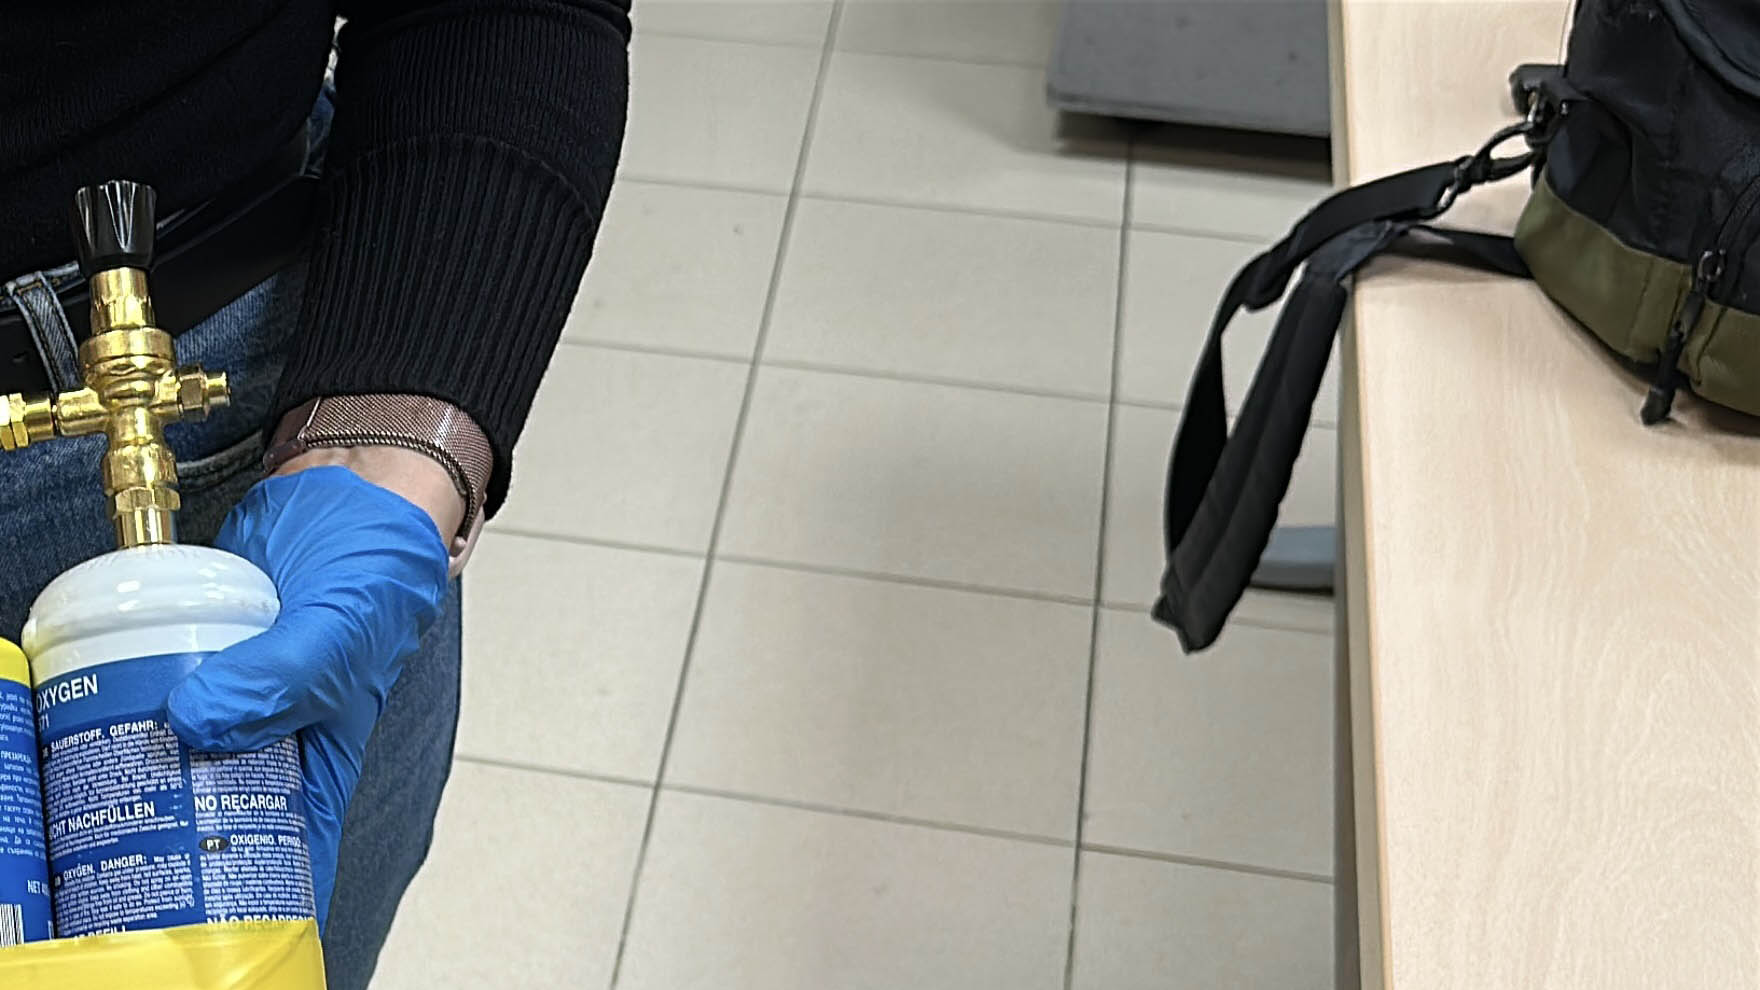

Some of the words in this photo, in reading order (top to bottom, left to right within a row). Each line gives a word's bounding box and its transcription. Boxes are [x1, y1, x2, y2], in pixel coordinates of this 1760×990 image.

[36, 673, 98, 713] OXYGEN
[51, 728, 105, 753] SAUERSTOFF.
[110, 719, 158, 738] GEFAHR:
[68, 800, 155, 832] NACHFÜLLEN
[194, 796, 217, 811] NO
[221, 794, 287, 811] RECARGAR
[206, 839, 221, 850] PT
[63, 863, 95, 882] OXYGEN.
[100, 853, 147, 872] DANGER:
